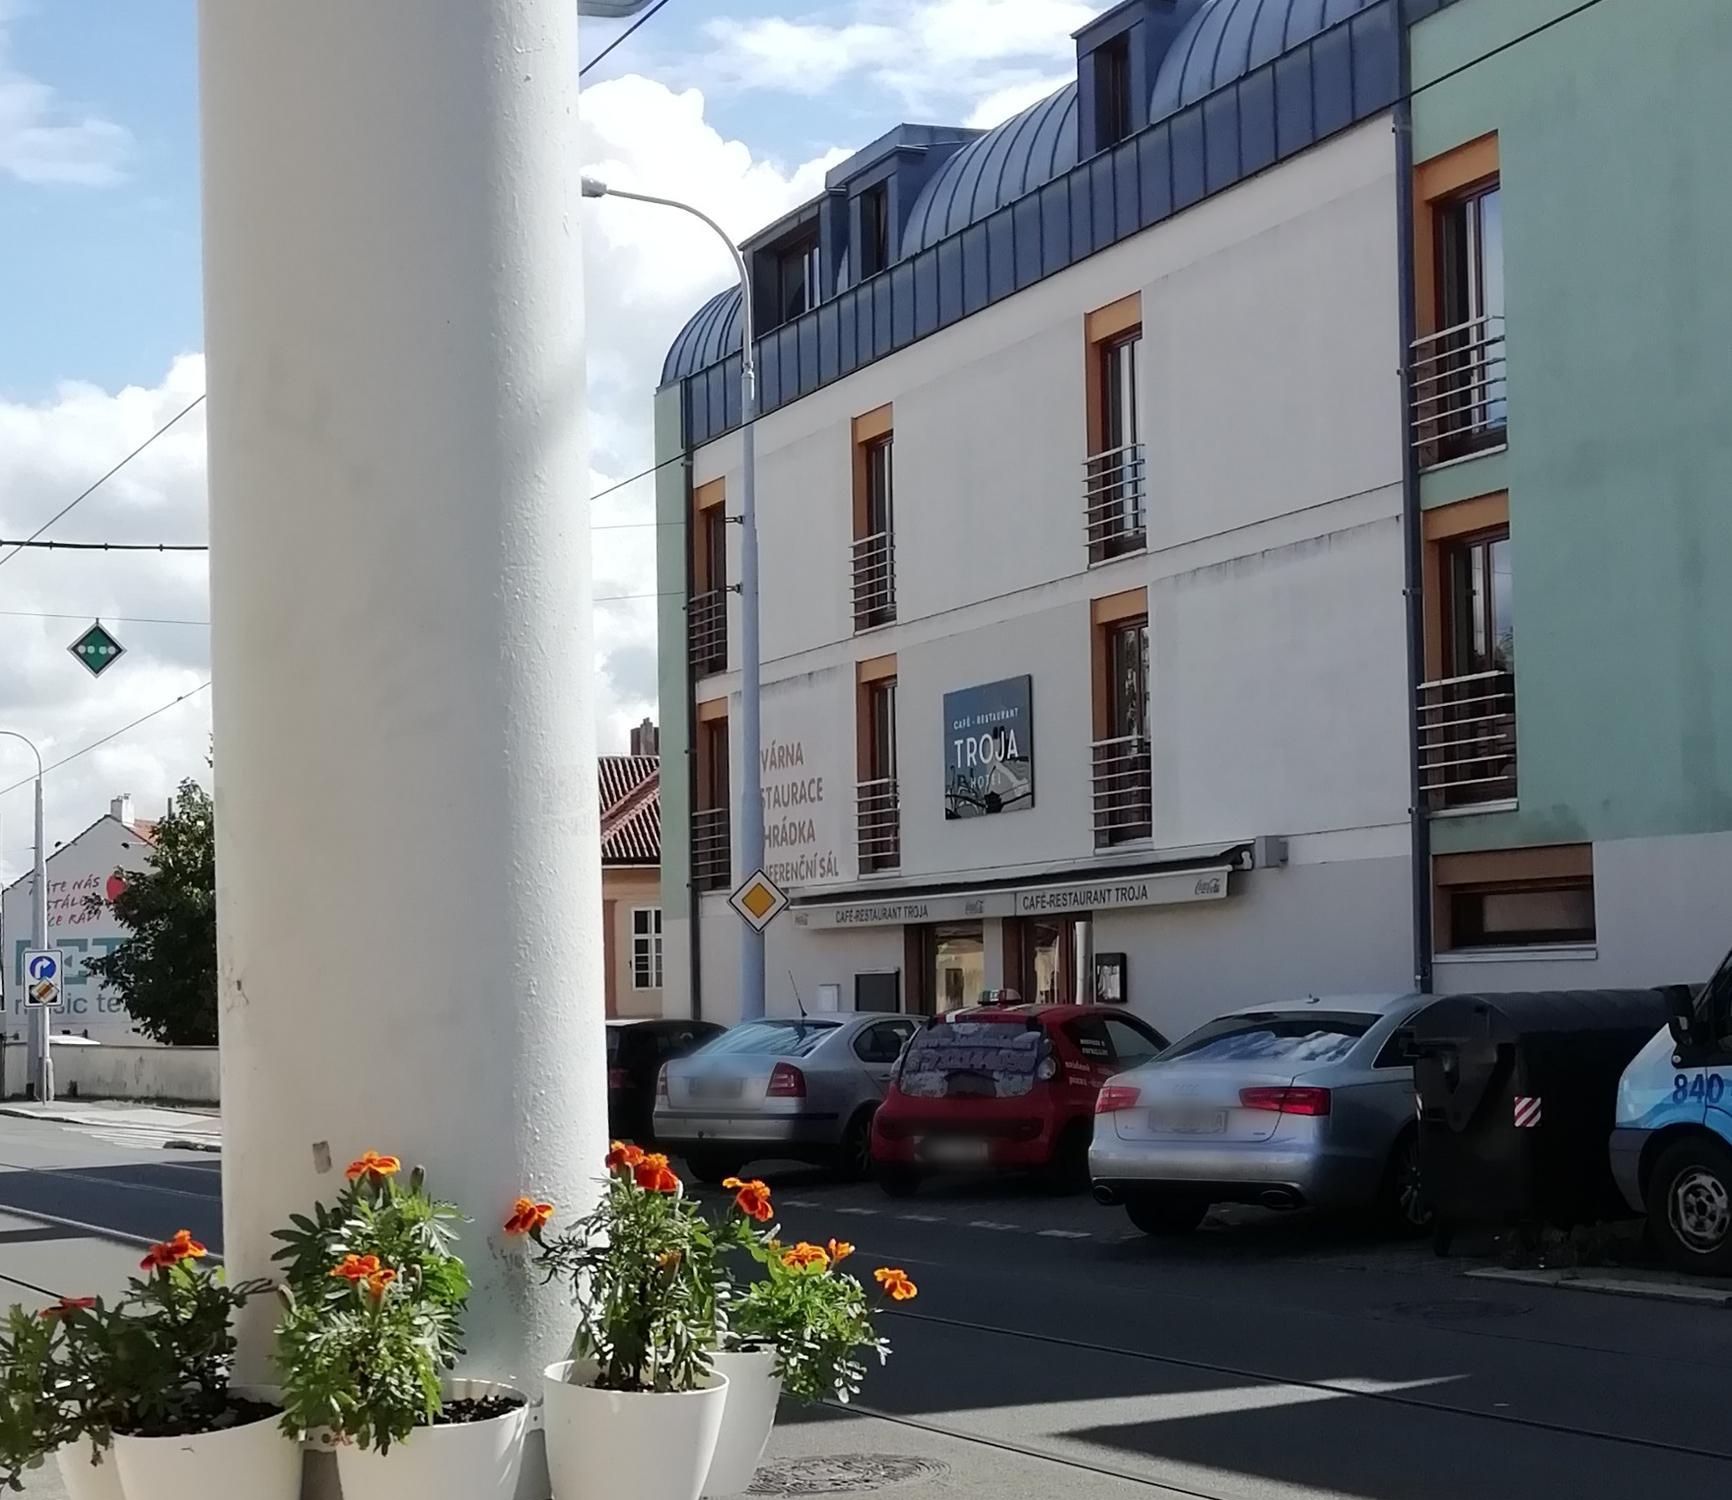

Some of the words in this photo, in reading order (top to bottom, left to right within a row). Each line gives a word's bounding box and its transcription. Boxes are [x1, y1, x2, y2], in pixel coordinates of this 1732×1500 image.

[760, 740, 804, 771] VÁRNA
[954, 728, 1019, 769] TROJA
[760, 777, 824, 810] STAURACE
[764, 816, 816, 849] HRÁDKA
[766, 852, 818, 883] FERENČNÍ
[819, 851, 840, 879] SÁL
[1115, 885, 1149, 902] TROJA
[904, 904, 929, 919] TROJA
[1672, 1073, 1725, 1105] 840
